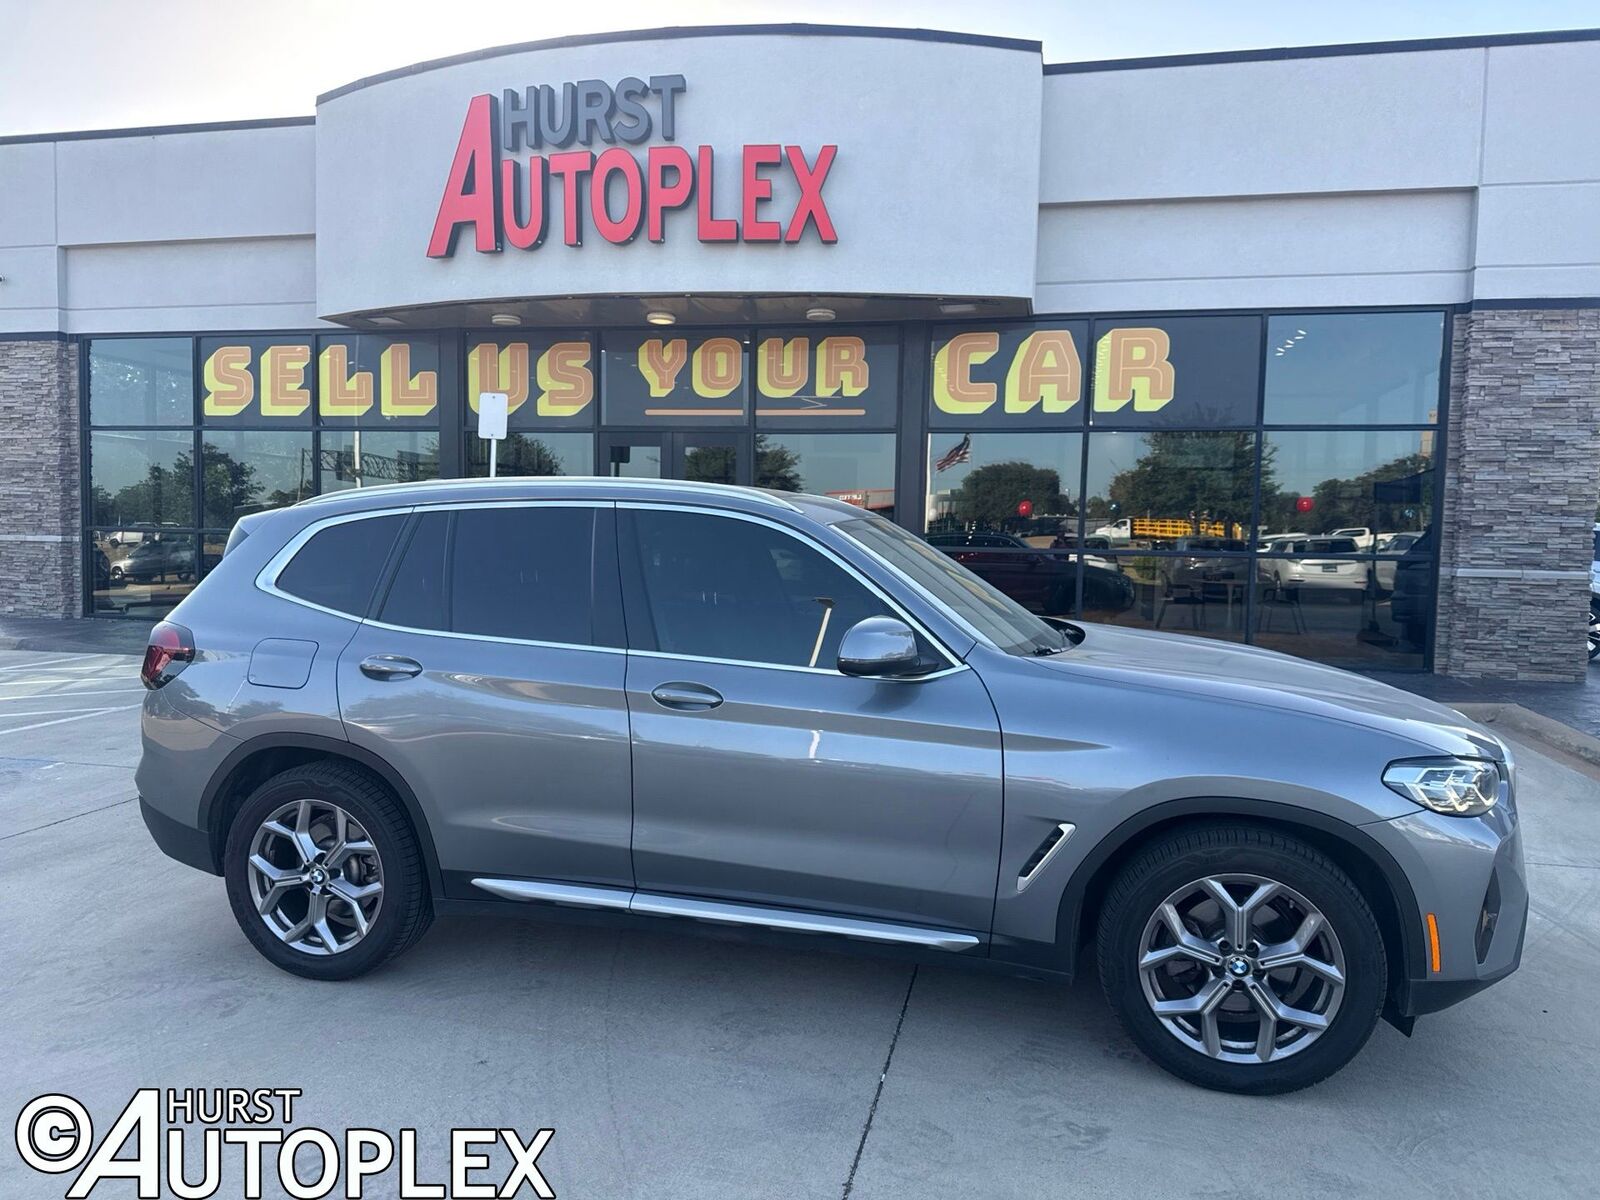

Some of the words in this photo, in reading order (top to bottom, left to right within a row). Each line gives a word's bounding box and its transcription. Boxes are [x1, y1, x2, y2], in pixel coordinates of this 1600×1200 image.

[503, 74, 687, 152] HURST
[426, 94, 839, 258] AUTOPLEX
[203, 343, 438, 417] SELL
[468, 341, 594, 417] US
[638, 336, 870, 398] YOUR
[933, 327, 1176, 414] CAR
